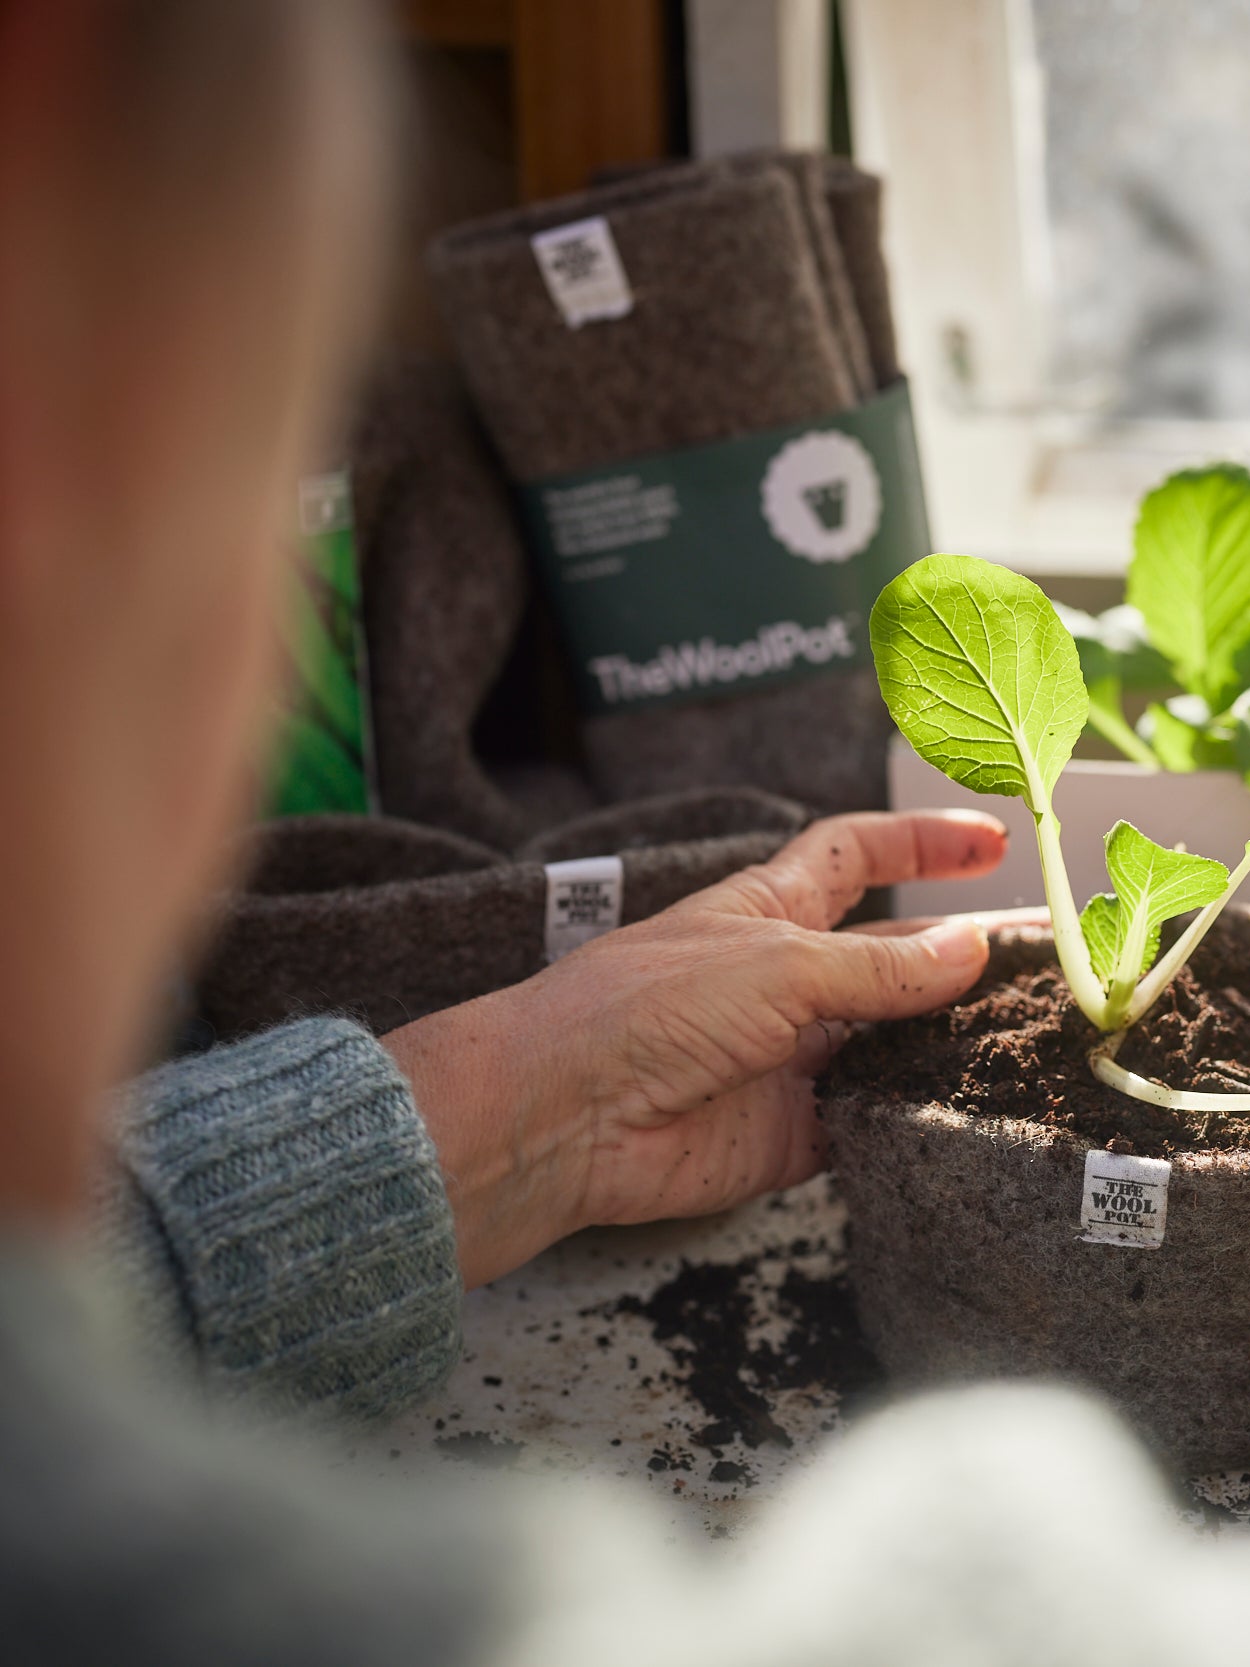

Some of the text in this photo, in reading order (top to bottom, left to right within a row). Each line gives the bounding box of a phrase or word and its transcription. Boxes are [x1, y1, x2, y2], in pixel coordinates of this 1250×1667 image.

[591, 618, 853, 703] TheWoolPot
[1106, 1181, 1143, 1198] THE
[1091, 1192, 1157, 1214] WOOL
[1104, 1210, 1141, 1224] POT
